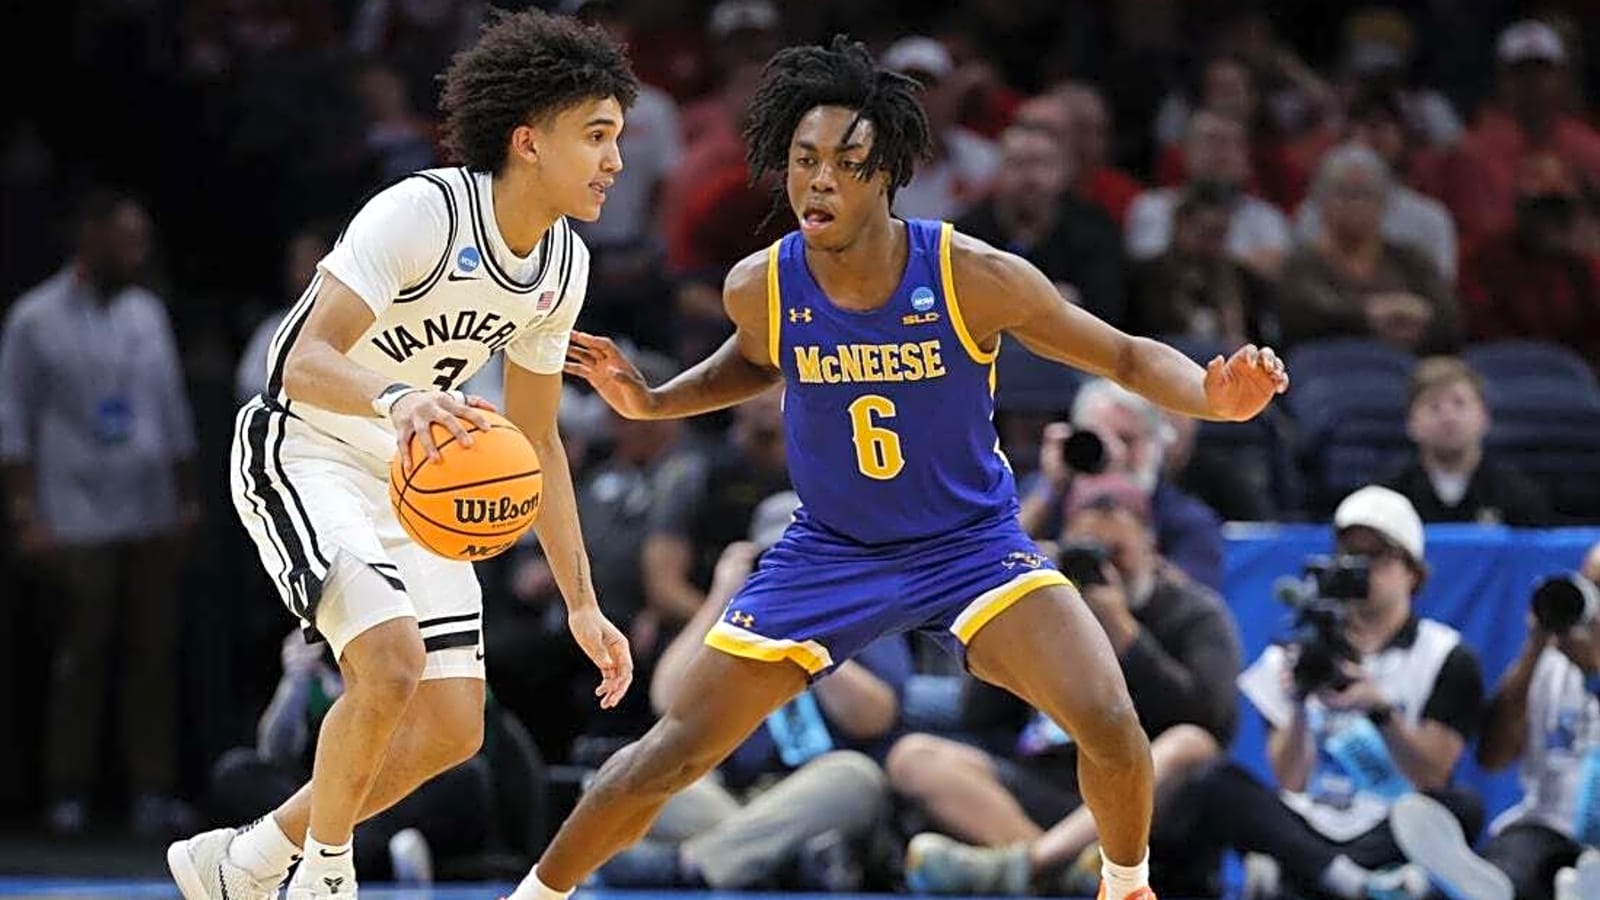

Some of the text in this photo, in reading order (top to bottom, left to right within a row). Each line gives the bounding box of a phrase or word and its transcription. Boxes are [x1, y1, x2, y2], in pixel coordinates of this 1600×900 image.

[372, 310, 516, 363] VANDER
[793, 340, 946, 384] McNEESE
[848, 394, 905, 480] 6
[454, 492, 539, 523] Wilson
